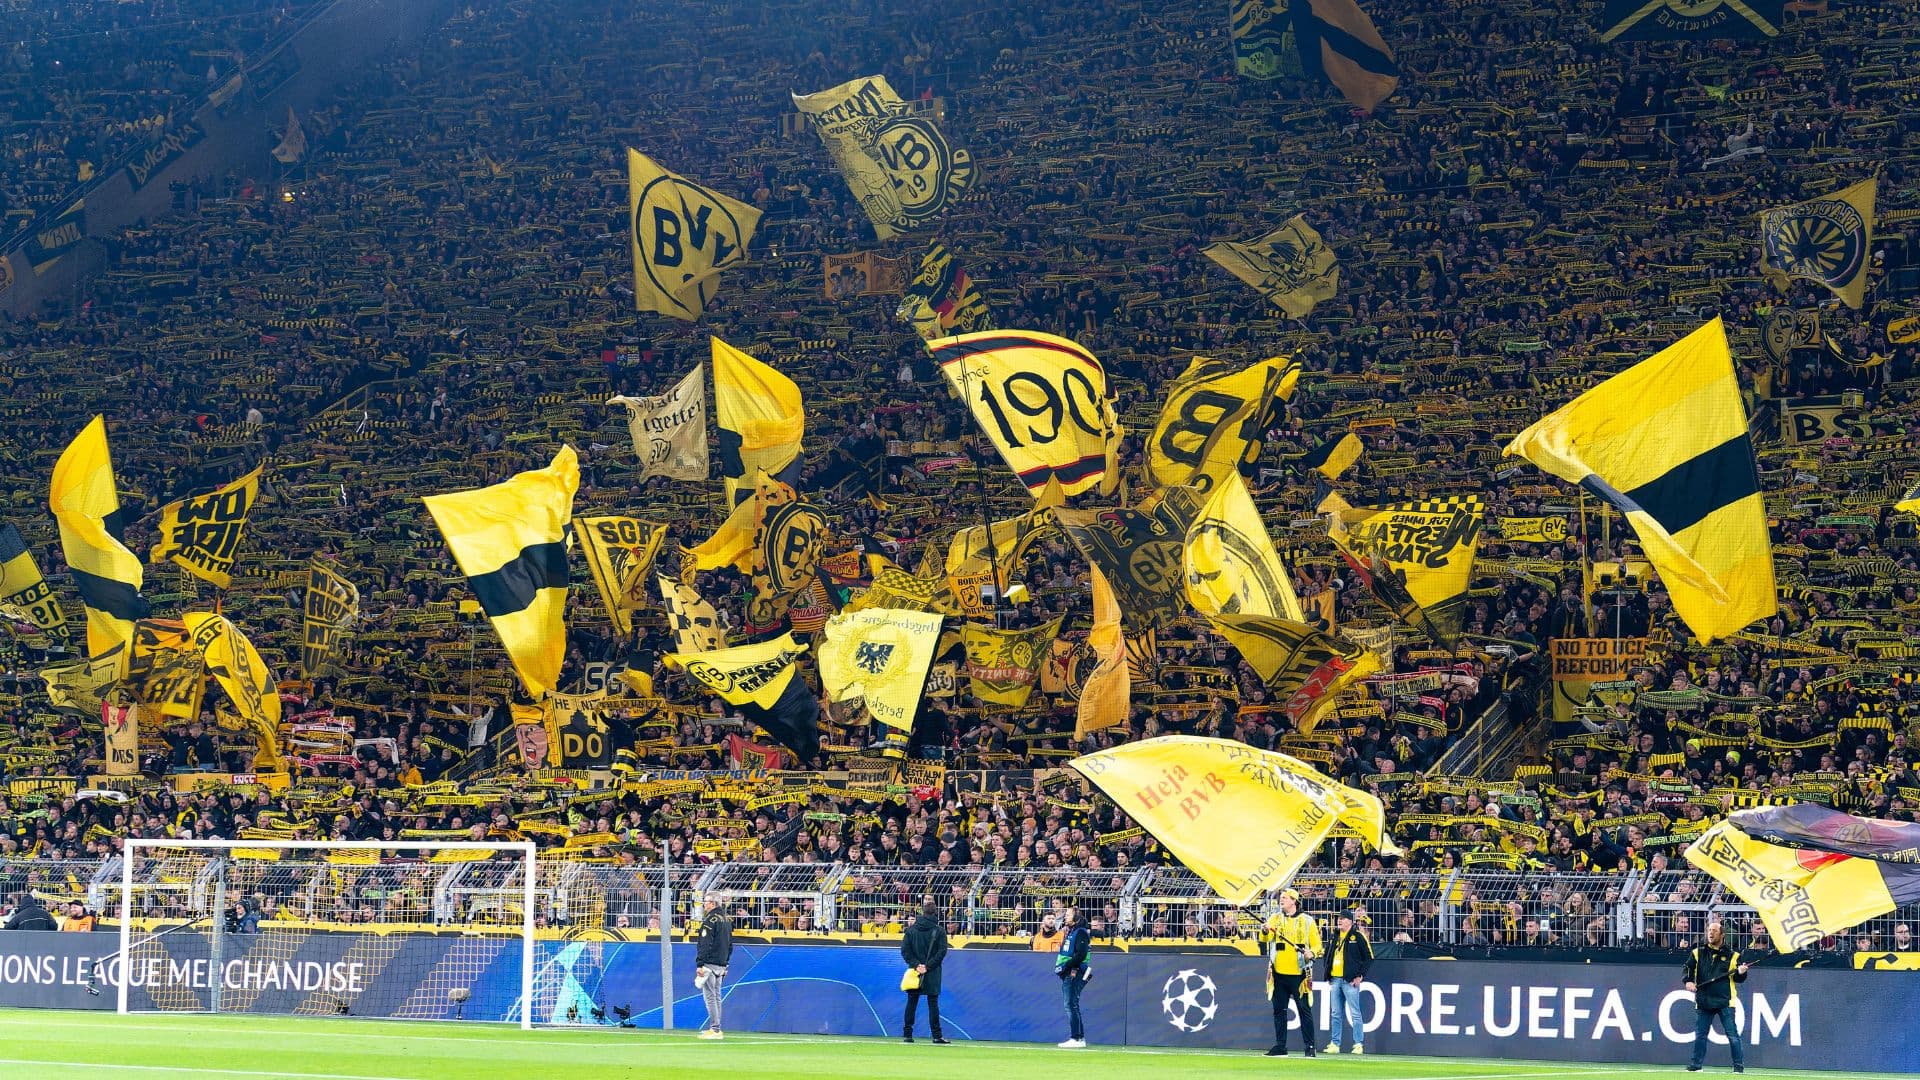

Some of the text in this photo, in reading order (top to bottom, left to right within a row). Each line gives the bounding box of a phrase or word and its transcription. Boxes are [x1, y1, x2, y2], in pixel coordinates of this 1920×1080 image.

[980, 367, 1105, 449] 190
[1556, 640, 1580, 656] NO
[1586, 640, 1607, 656] TO
[563, 733, 603, 758] DO
[539, 769, 590, 781] HEILIGENHAUS
[1135, 763, 1190, 812] Heja
[1179, 771, 1228, 823] BVB
[1655, 796, 1684, 804] MILAN
